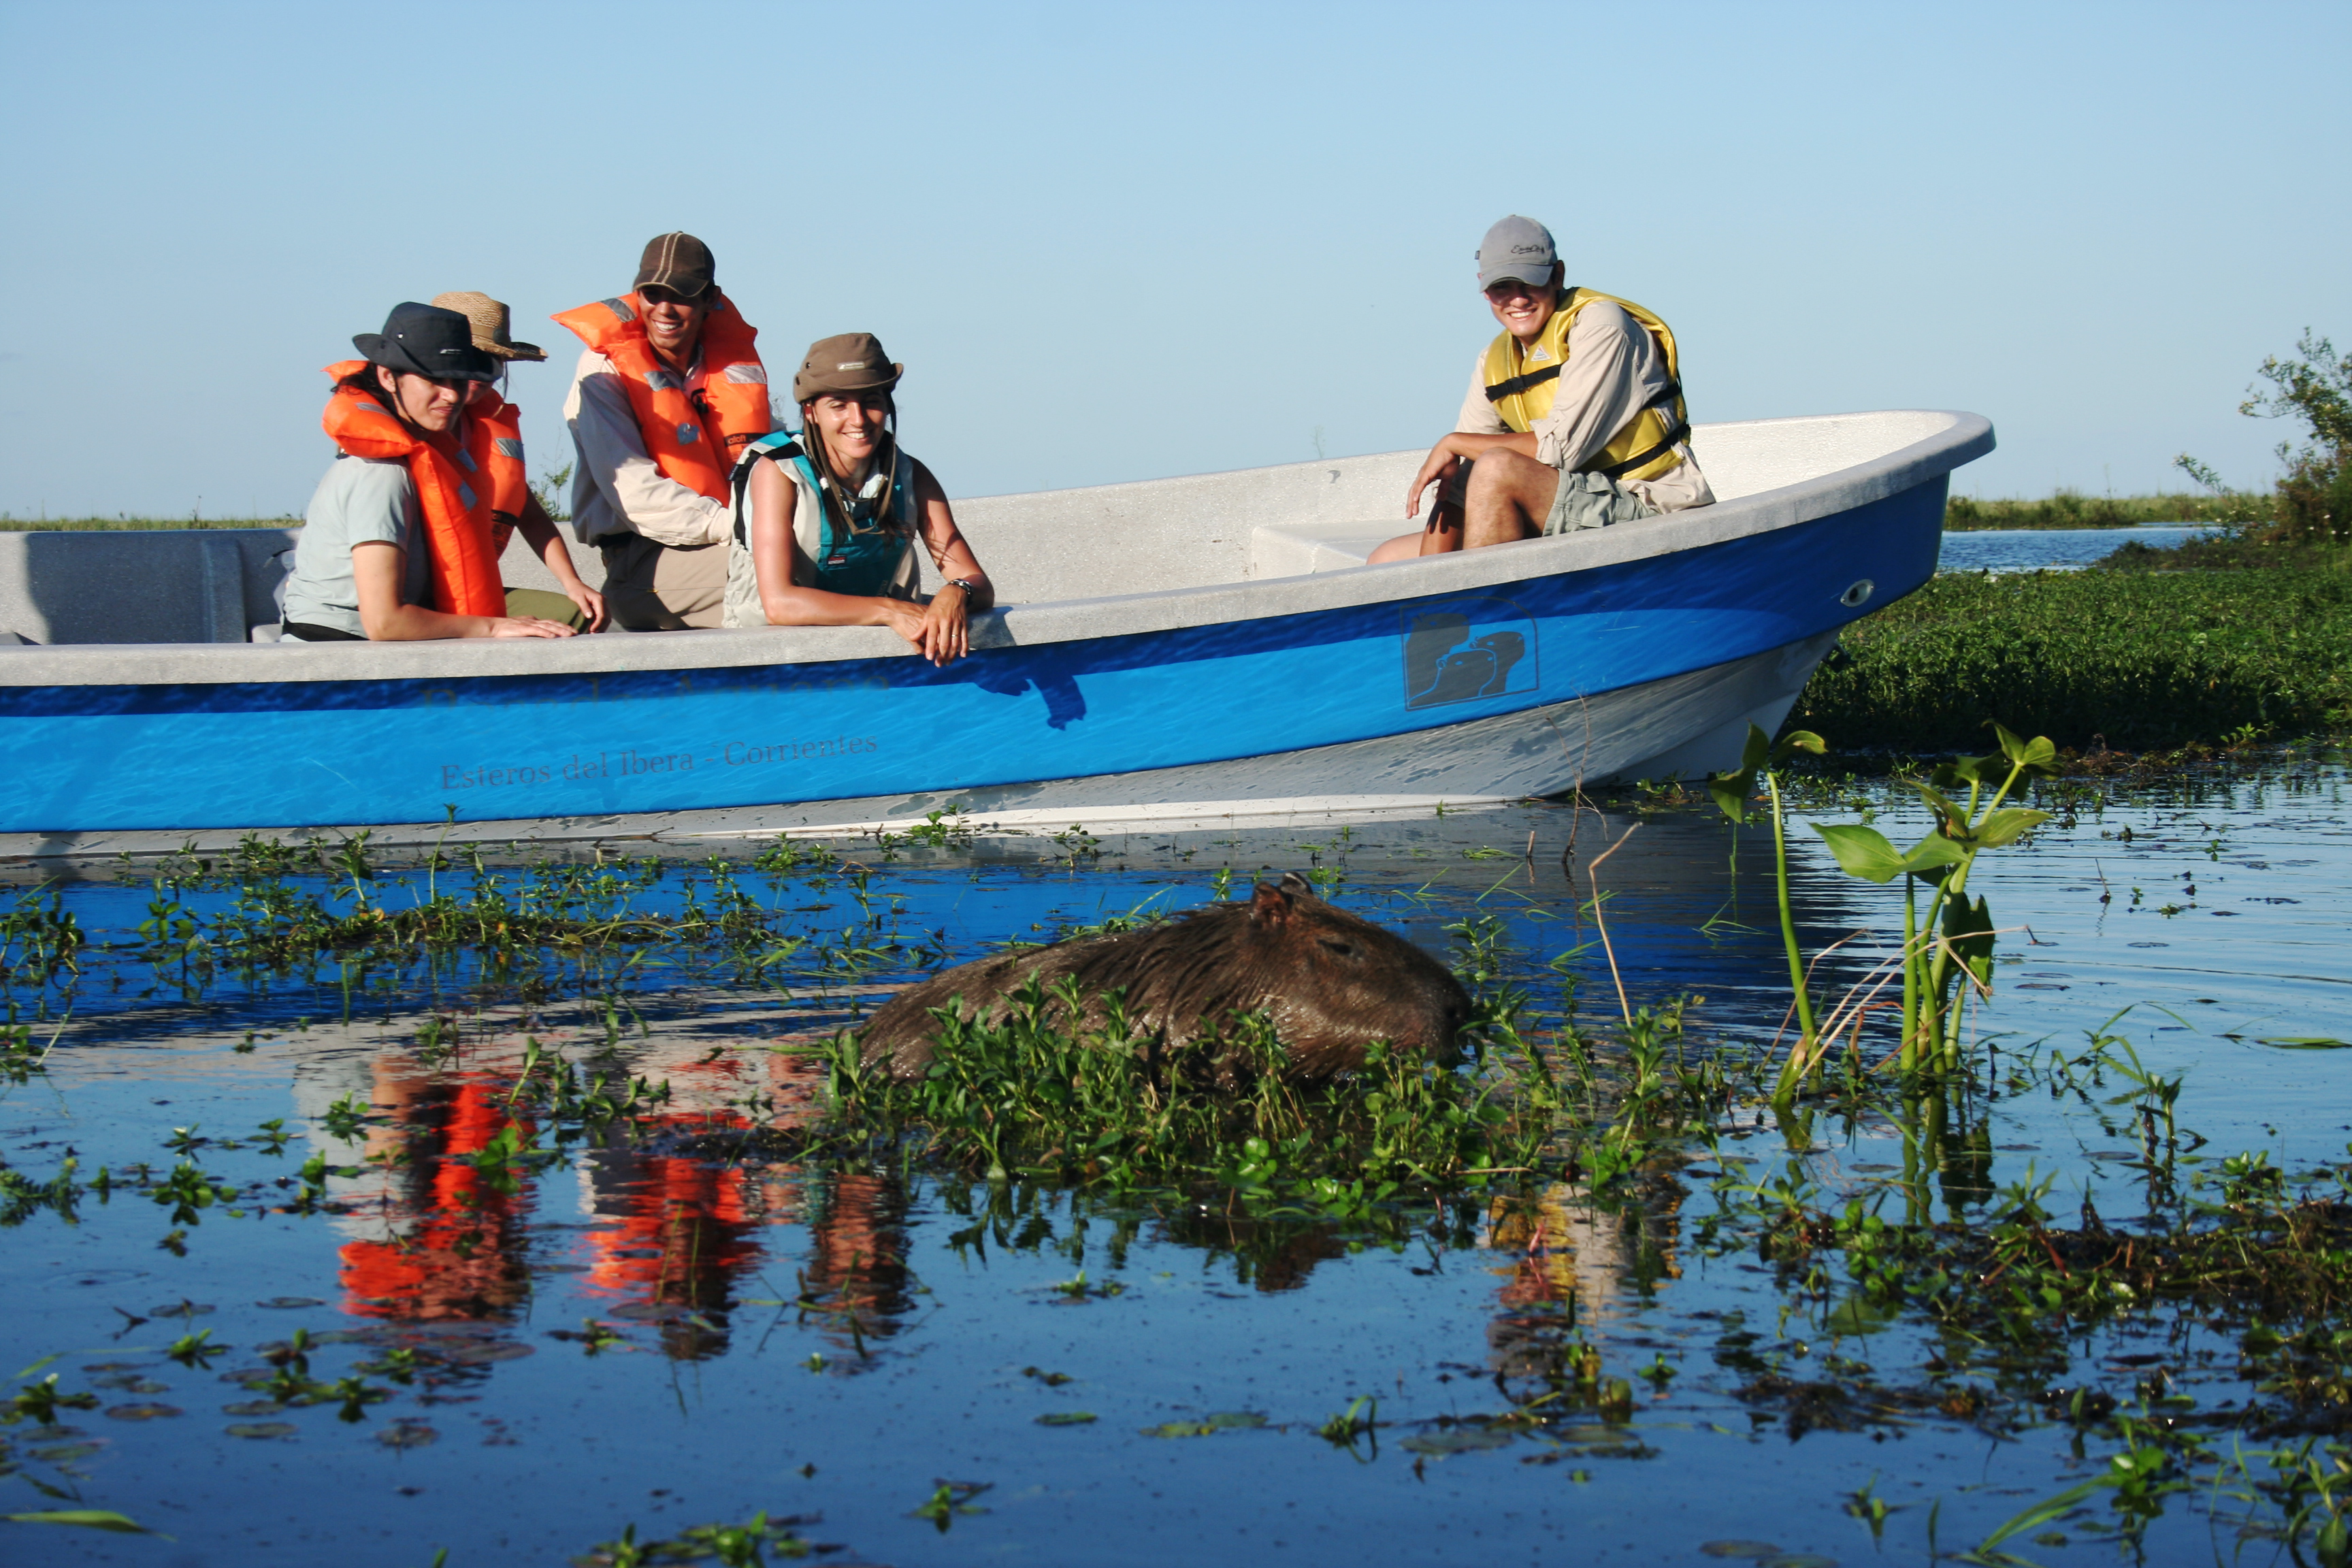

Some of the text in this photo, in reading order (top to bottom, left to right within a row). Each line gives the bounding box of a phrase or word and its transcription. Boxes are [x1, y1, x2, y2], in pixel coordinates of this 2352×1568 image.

[442, 764, 551, 789] Esteros
[563, 752, 608, 781] del
[621, 749, 693, 775] Ibera
[725, 734, 877, 766] Corrientes
